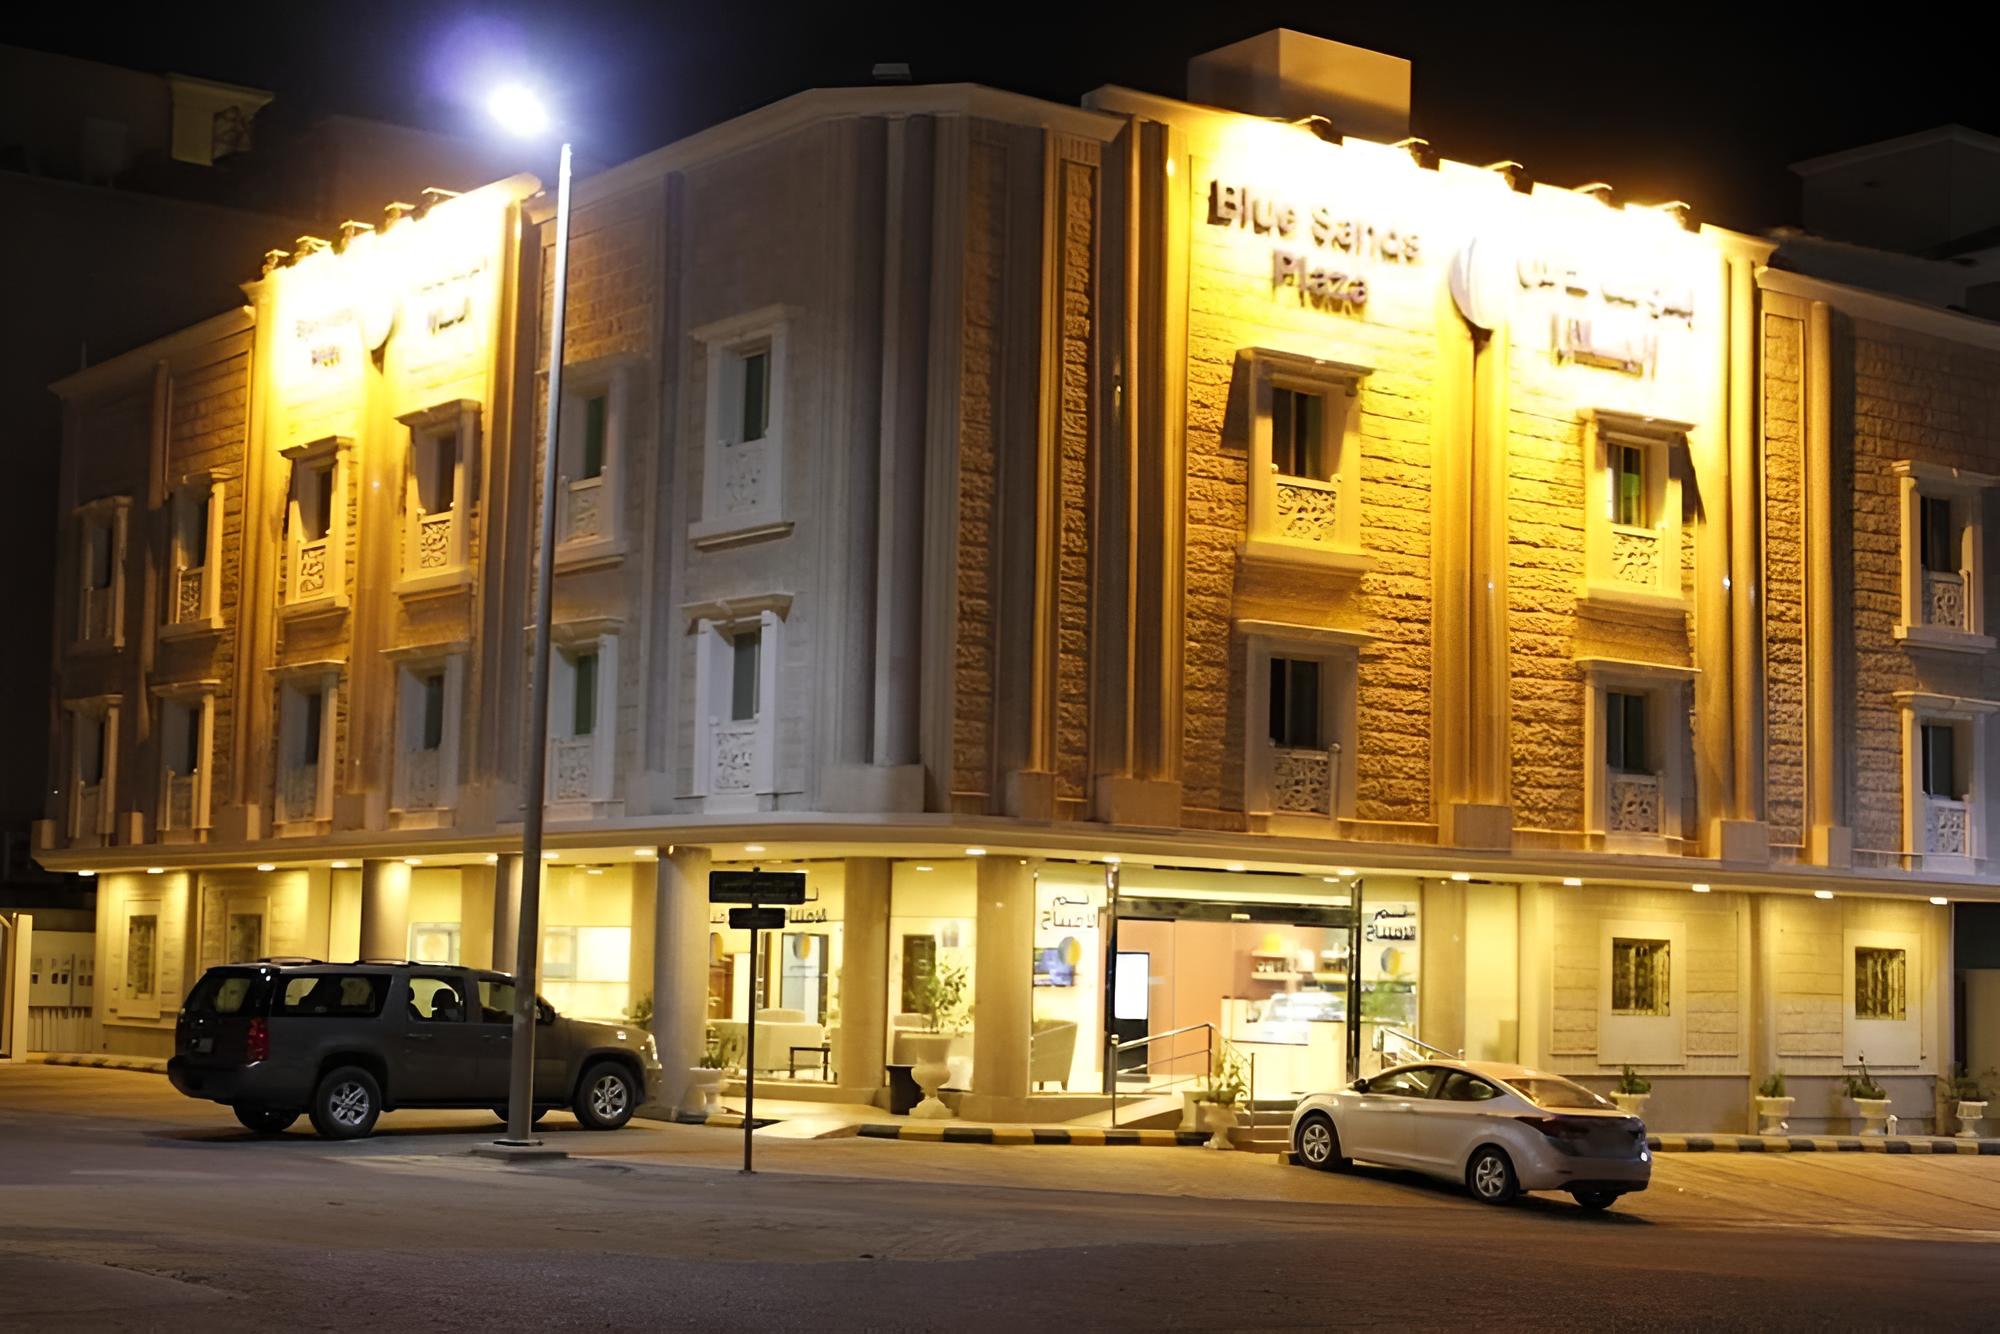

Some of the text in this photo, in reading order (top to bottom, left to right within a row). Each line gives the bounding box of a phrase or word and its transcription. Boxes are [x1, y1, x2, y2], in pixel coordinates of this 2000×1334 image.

[1206, 179, 1422, 265] Blue Sands
[1273, 248, 1368, 312] Plaza
